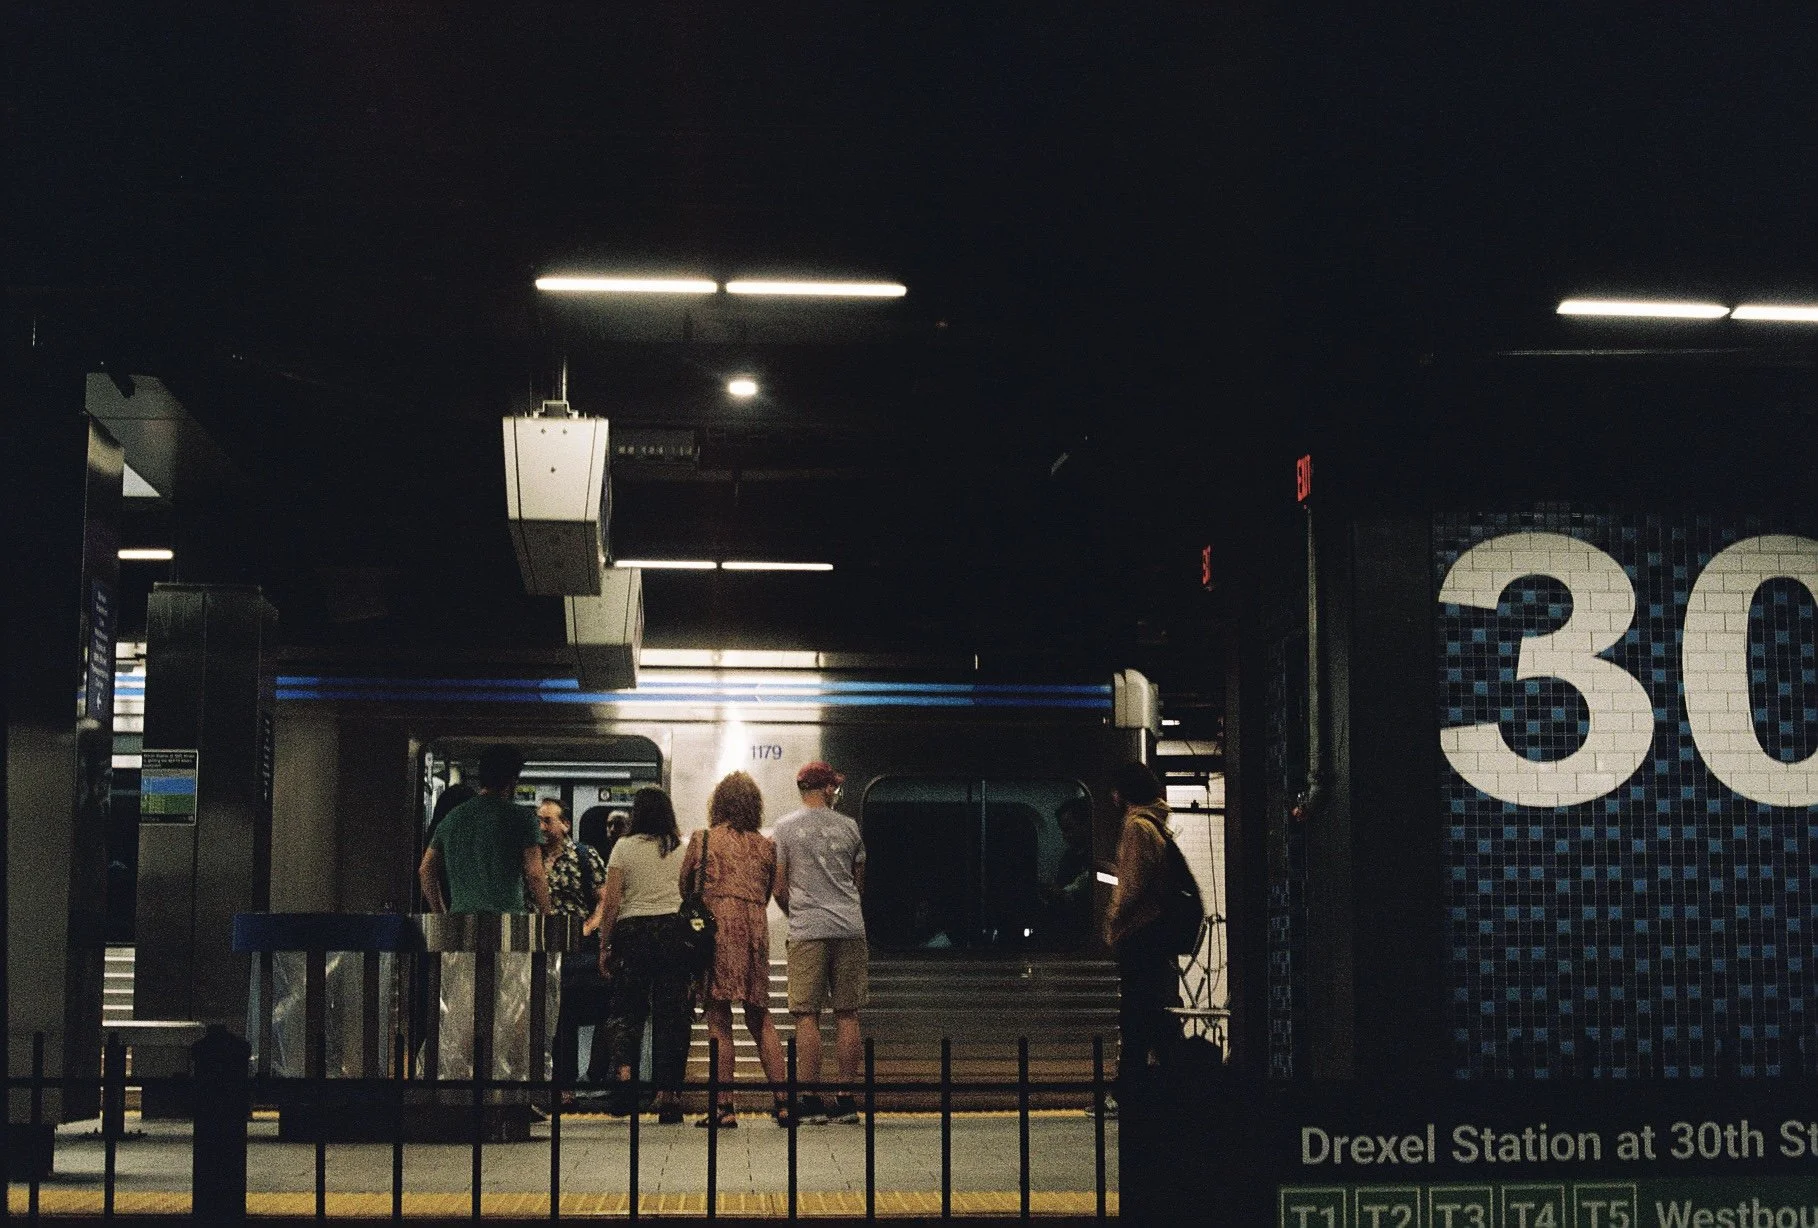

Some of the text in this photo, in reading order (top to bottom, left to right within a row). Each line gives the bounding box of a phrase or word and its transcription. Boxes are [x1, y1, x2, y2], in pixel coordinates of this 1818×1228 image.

[1438, 531, 1818, 808] 30
[752, 745, 783, 760] 1179
[1301, 1122, 1435, 1165] Drexel
[1452, 1121, 1602, 1164] Station
[1616, 1125, 1656, 1161] at
[1670, 1119, 1765, 1160] 30th
[1290, 1203, 1336, 1228] T1
[1362, 1203, 1412, 1228] T2
[1435, 1203, 1486, 1228] T3
[1509, 1201, 1558, 1228] T4
[1581, 1200, 1630, 1228] T5
